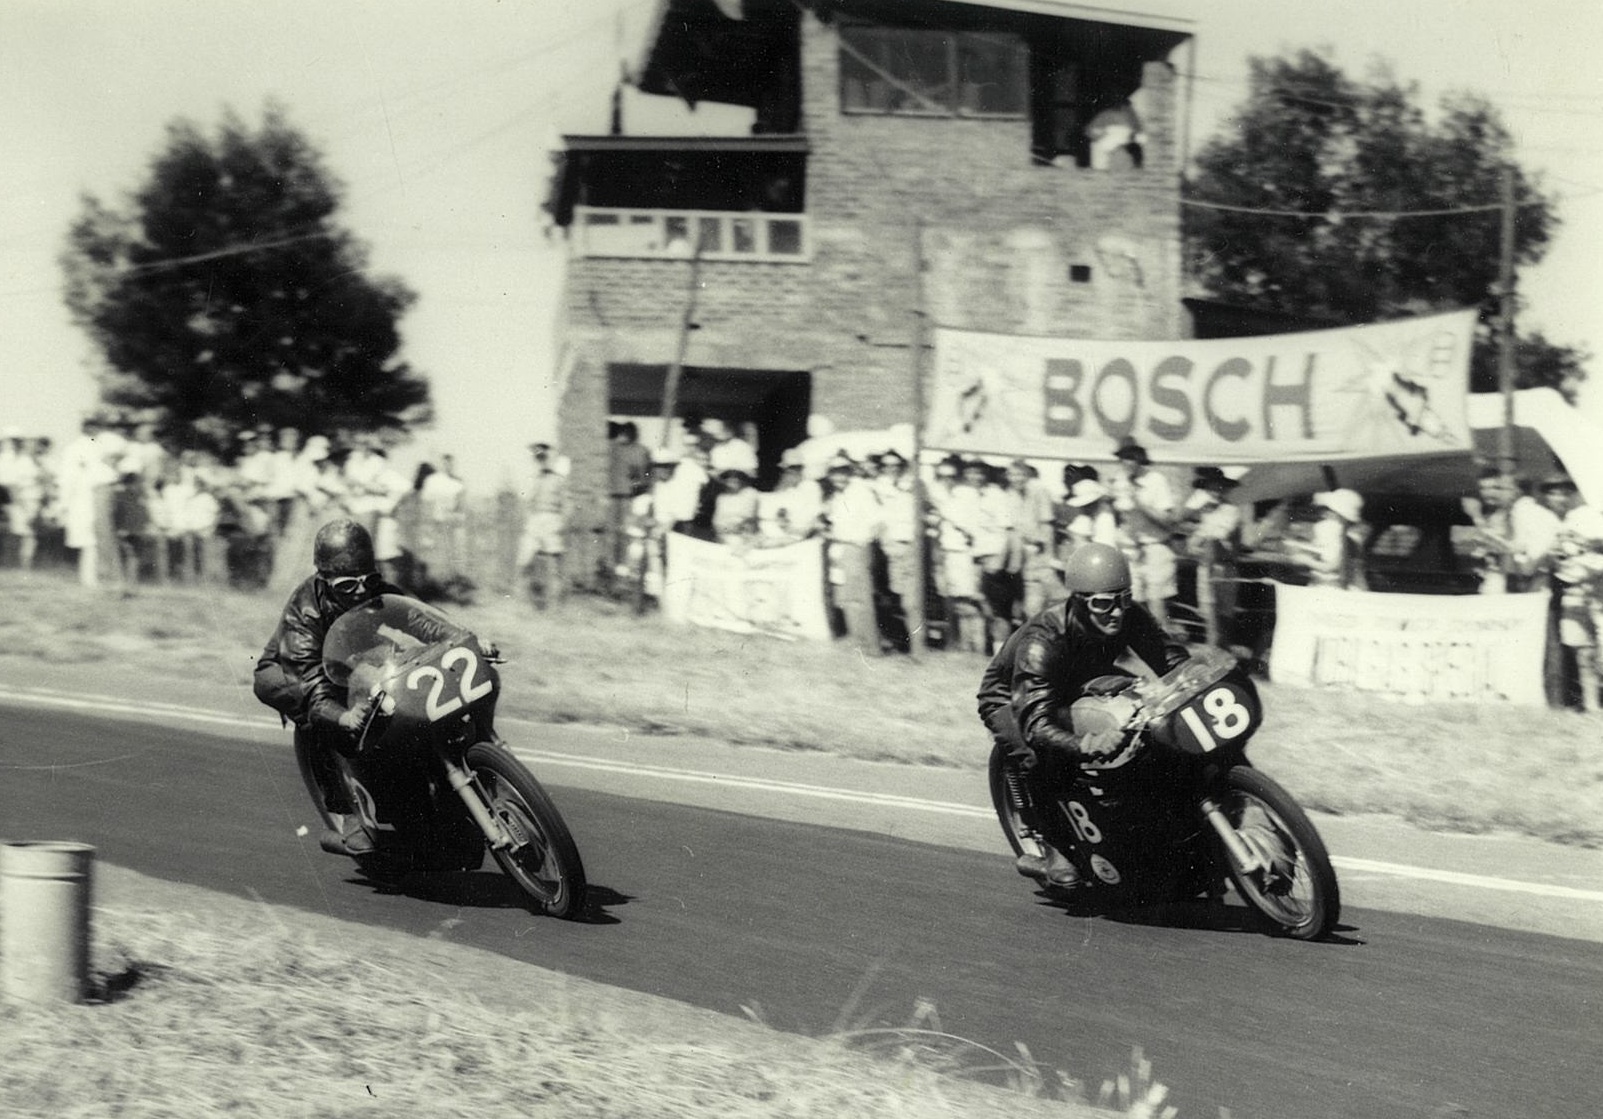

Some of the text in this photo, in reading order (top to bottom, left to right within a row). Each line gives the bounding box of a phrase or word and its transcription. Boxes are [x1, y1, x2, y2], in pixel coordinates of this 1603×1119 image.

[1043, 352, 1317, 442] BOSCH
[407, 647, 493, 722] 22
[1180, 687, 1250, 752] 18
[1057, 800, 1103, 844] 18
